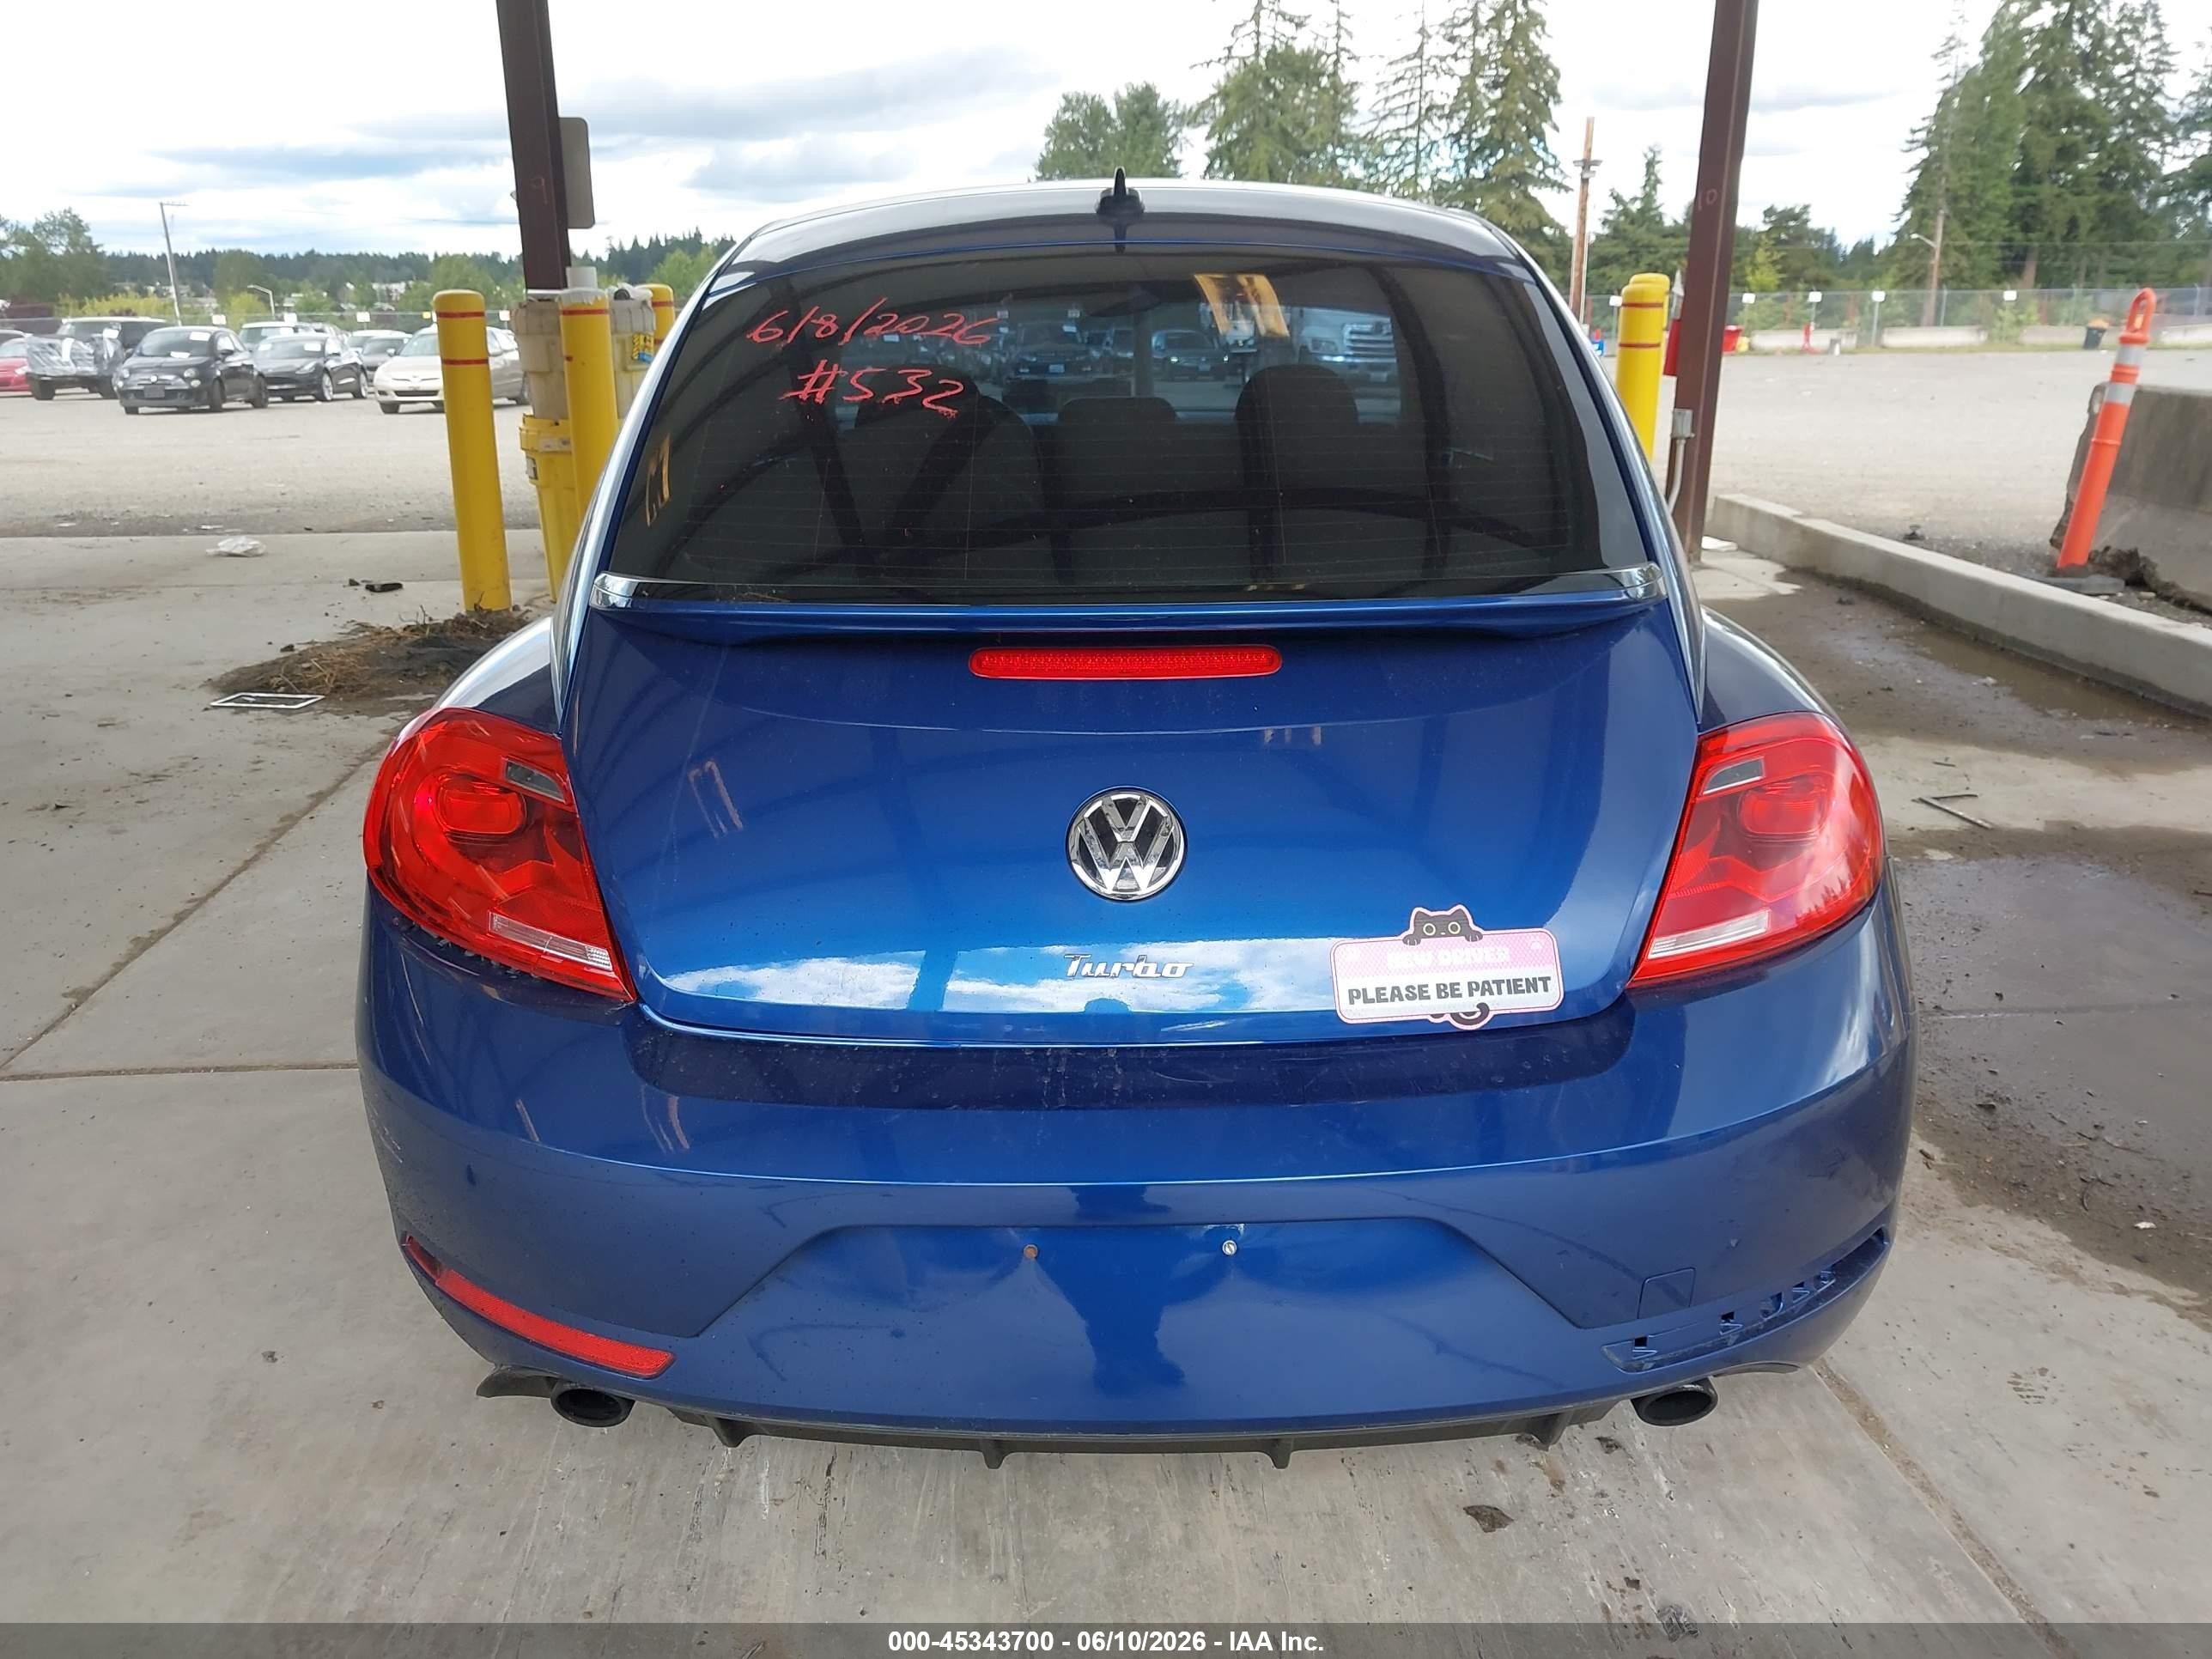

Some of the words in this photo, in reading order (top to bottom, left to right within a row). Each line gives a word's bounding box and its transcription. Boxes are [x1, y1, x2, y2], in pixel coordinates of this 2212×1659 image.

[746, 297, 999, 346] 6/8/2026
[778, 359, 964, 418] #532
[1063, 954, 1194, 978] Turbo
[1347, 983, 1431, 1005] PLEASE
[1436, 982, 1462, 1000] BE
[1468, 976, 1552, 997] PATIENT
